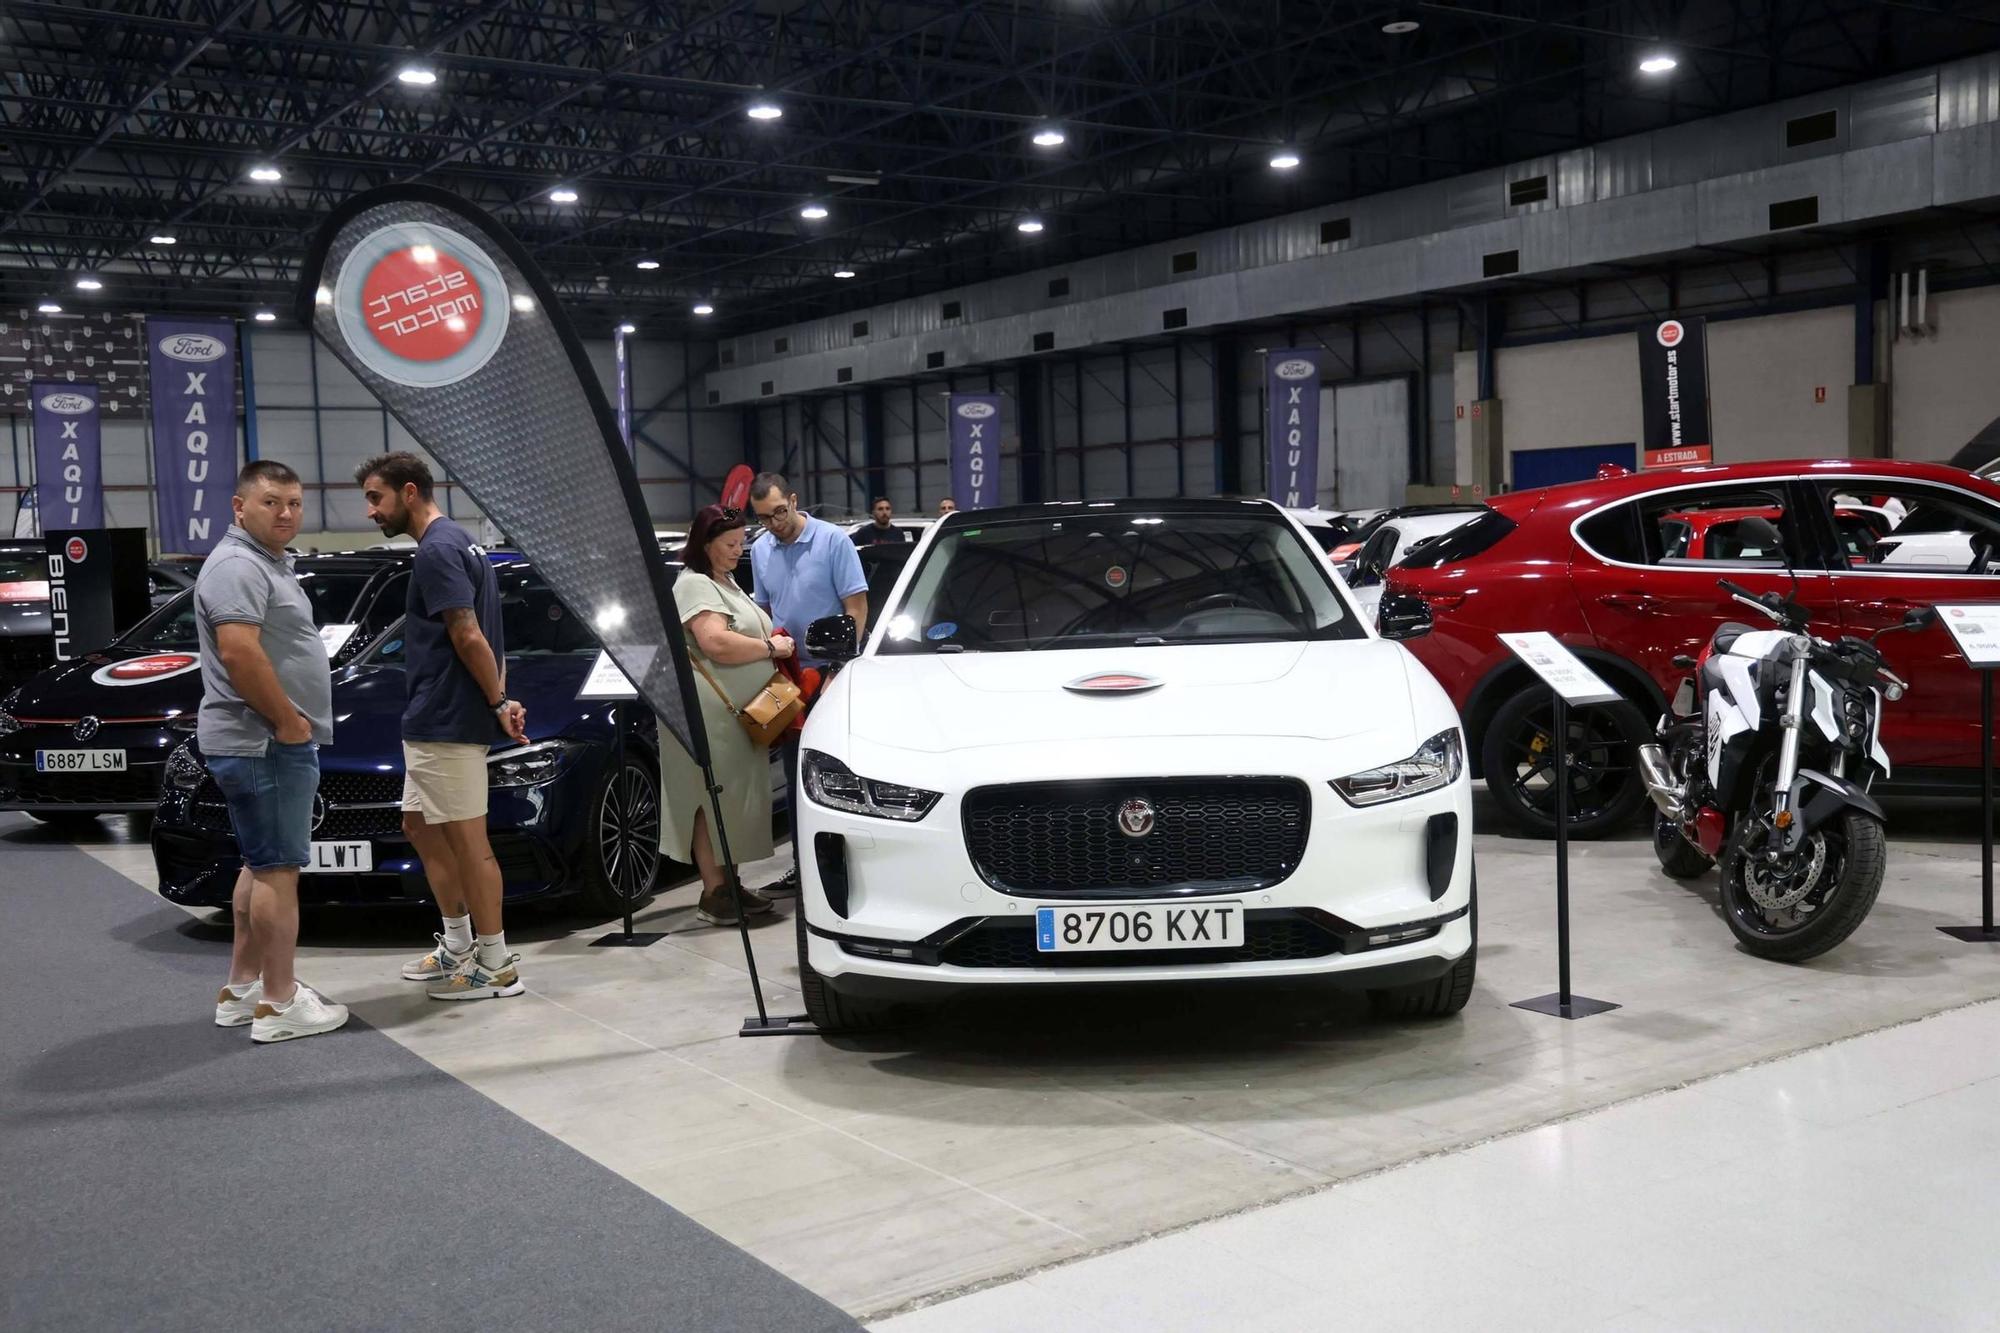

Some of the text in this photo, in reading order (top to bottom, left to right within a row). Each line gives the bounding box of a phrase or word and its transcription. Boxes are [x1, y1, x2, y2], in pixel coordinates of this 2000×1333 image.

[173, 337, 213, 357] Ford
[1282, 363, 1307, 376] Ford
[51, 396, 83, 411] Ford
[1666, 350, 1682, 447] www.startmotor.es
[183, 371, 210, 541] XAQUIN
[1286, 387, 1302, 508] XAQUIN
[1656, 450, 1698, 464] A ESTRADA
[969, 423, 984, 511] XAQUI
[46, 753, 86, 769] 6887
[92, 752, 123, 769] LSM
[318, 845, 362, 868] LWT
[1043, 908, 1234, 945] E 8706 KXT
